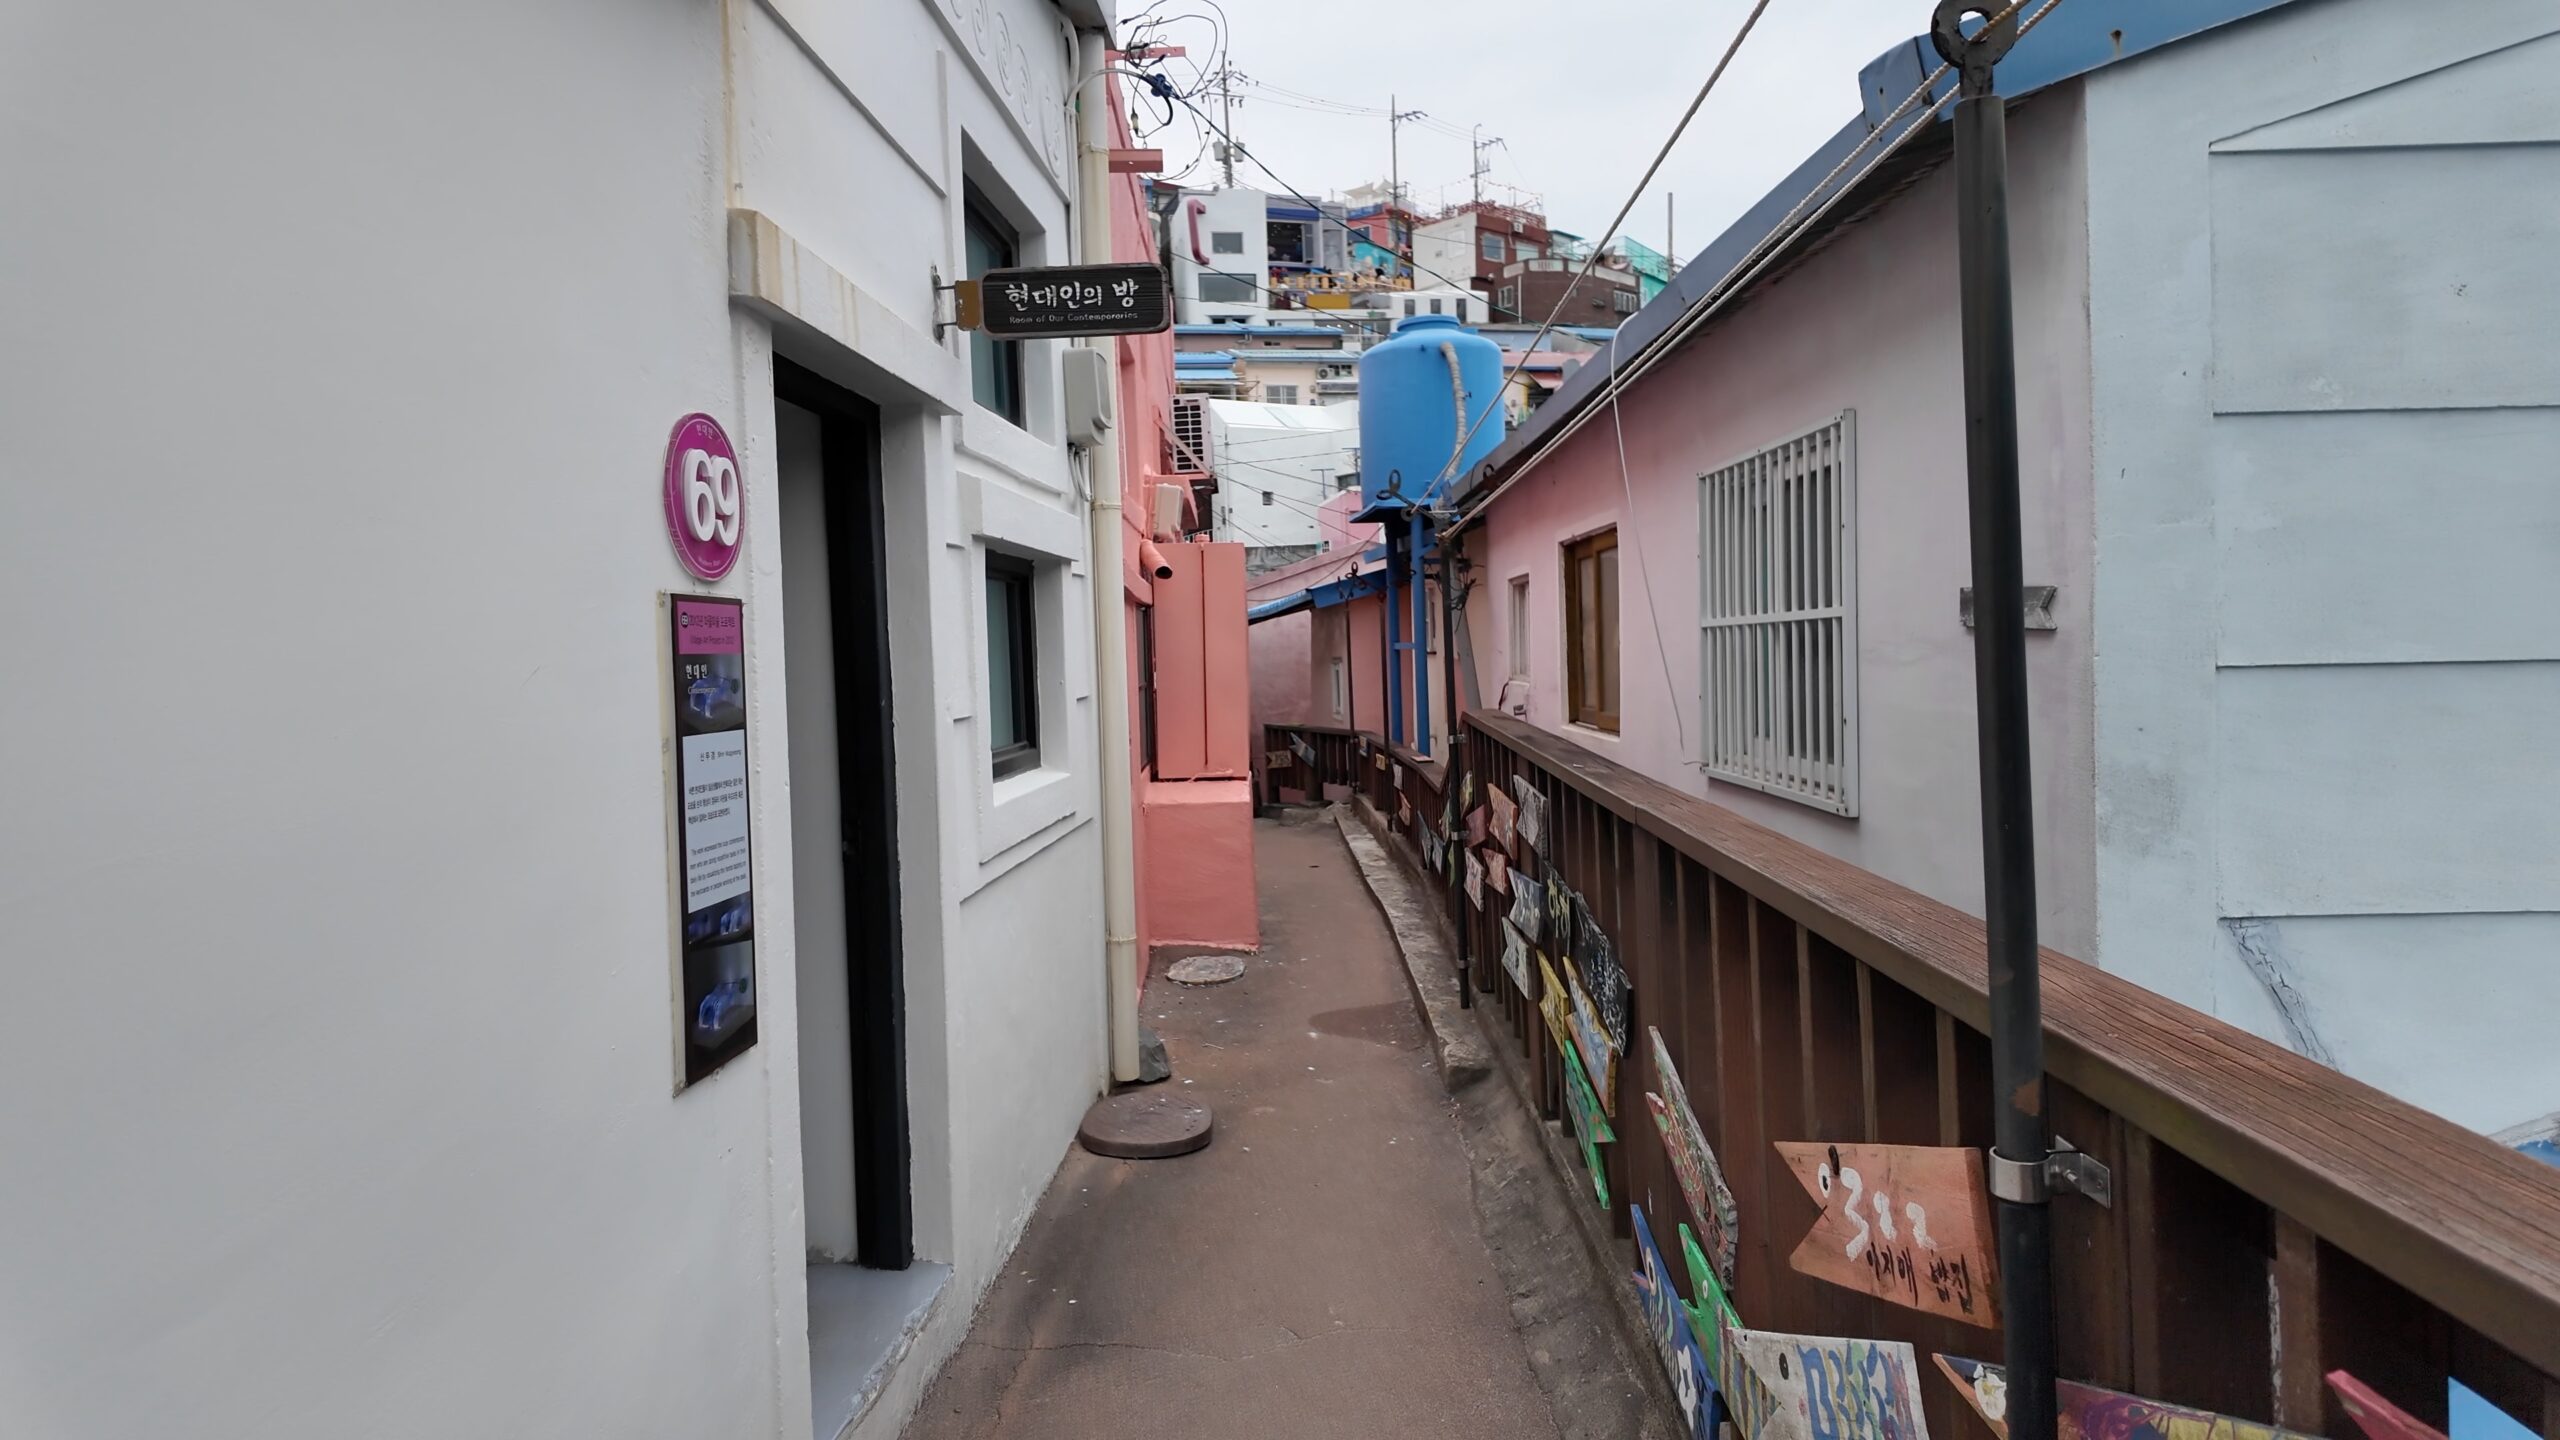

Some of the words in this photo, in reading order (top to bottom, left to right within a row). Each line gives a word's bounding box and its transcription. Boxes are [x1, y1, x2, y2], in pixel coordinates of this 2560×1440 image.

[1005, 281, 1103, 311] 현대인의
[1112, 278, 1140, 308] 방
[1009, 316, 1033, 325] Room
[1035, 315, 1045, 324] of
[1048, 314, 1064, 323] Our
[1067, 312, 1139, 322] Contemporaries
[683, 448, 740, 547] 69
[1866, 1242, 1918, 1306] 아지매
